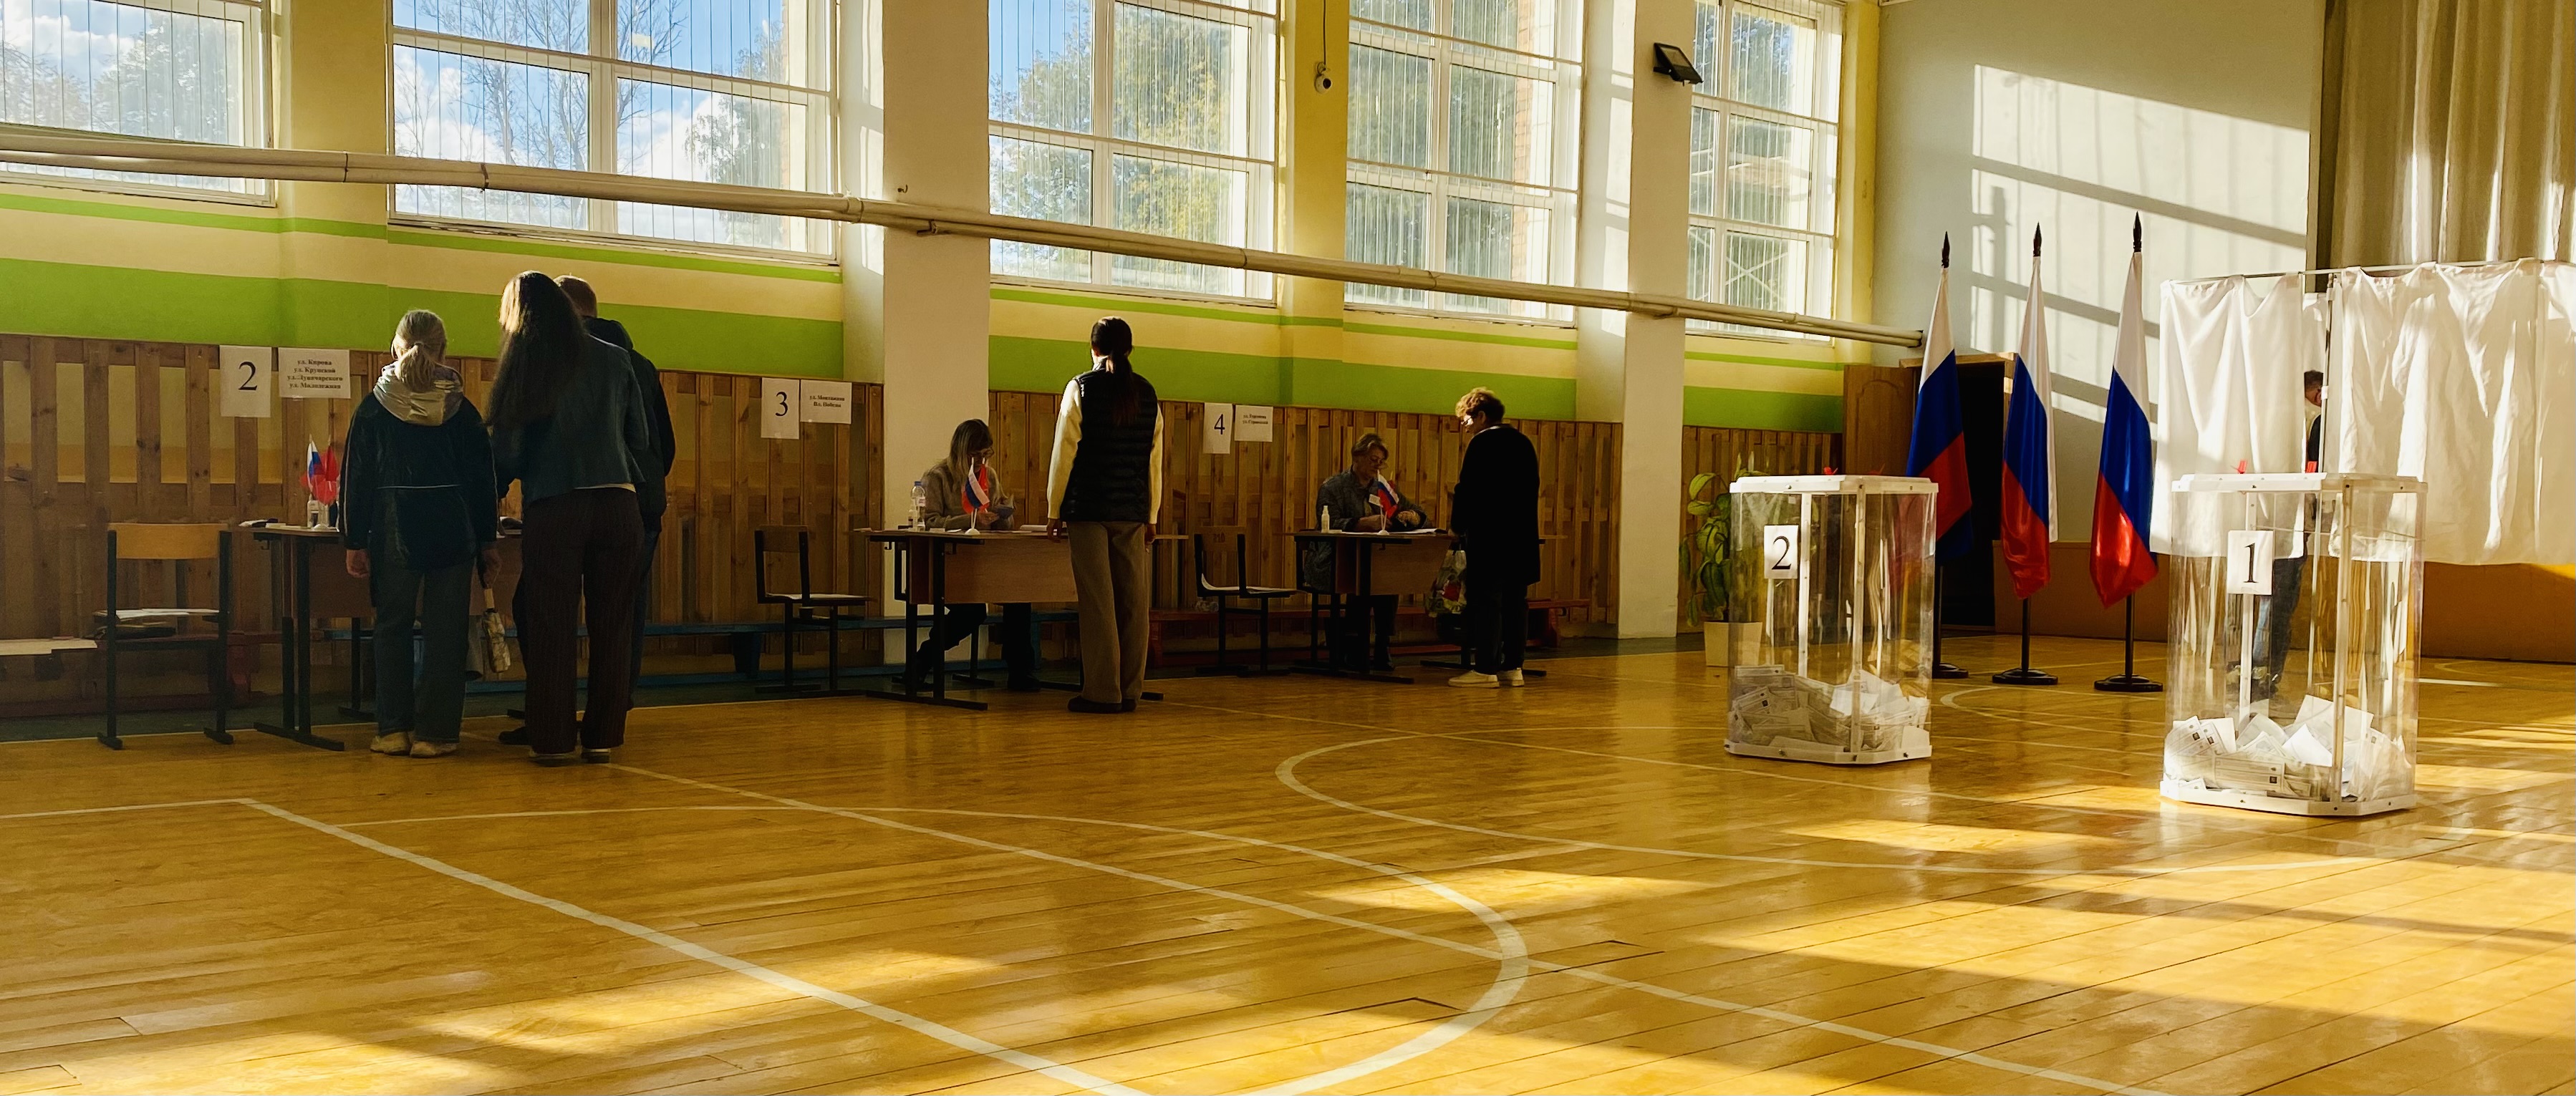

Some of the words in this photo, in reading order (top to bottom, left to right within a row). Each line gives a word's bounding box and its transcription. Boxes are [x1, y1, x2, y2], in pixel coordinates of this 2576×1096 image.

[238, 361, 258, 391] 2
[775, 392, 788, 417] 3
[1214, 414, 1225, 435] 4
[1771, 535, 1792, 570] 2
[2243, 543, 2259, 583] 1
